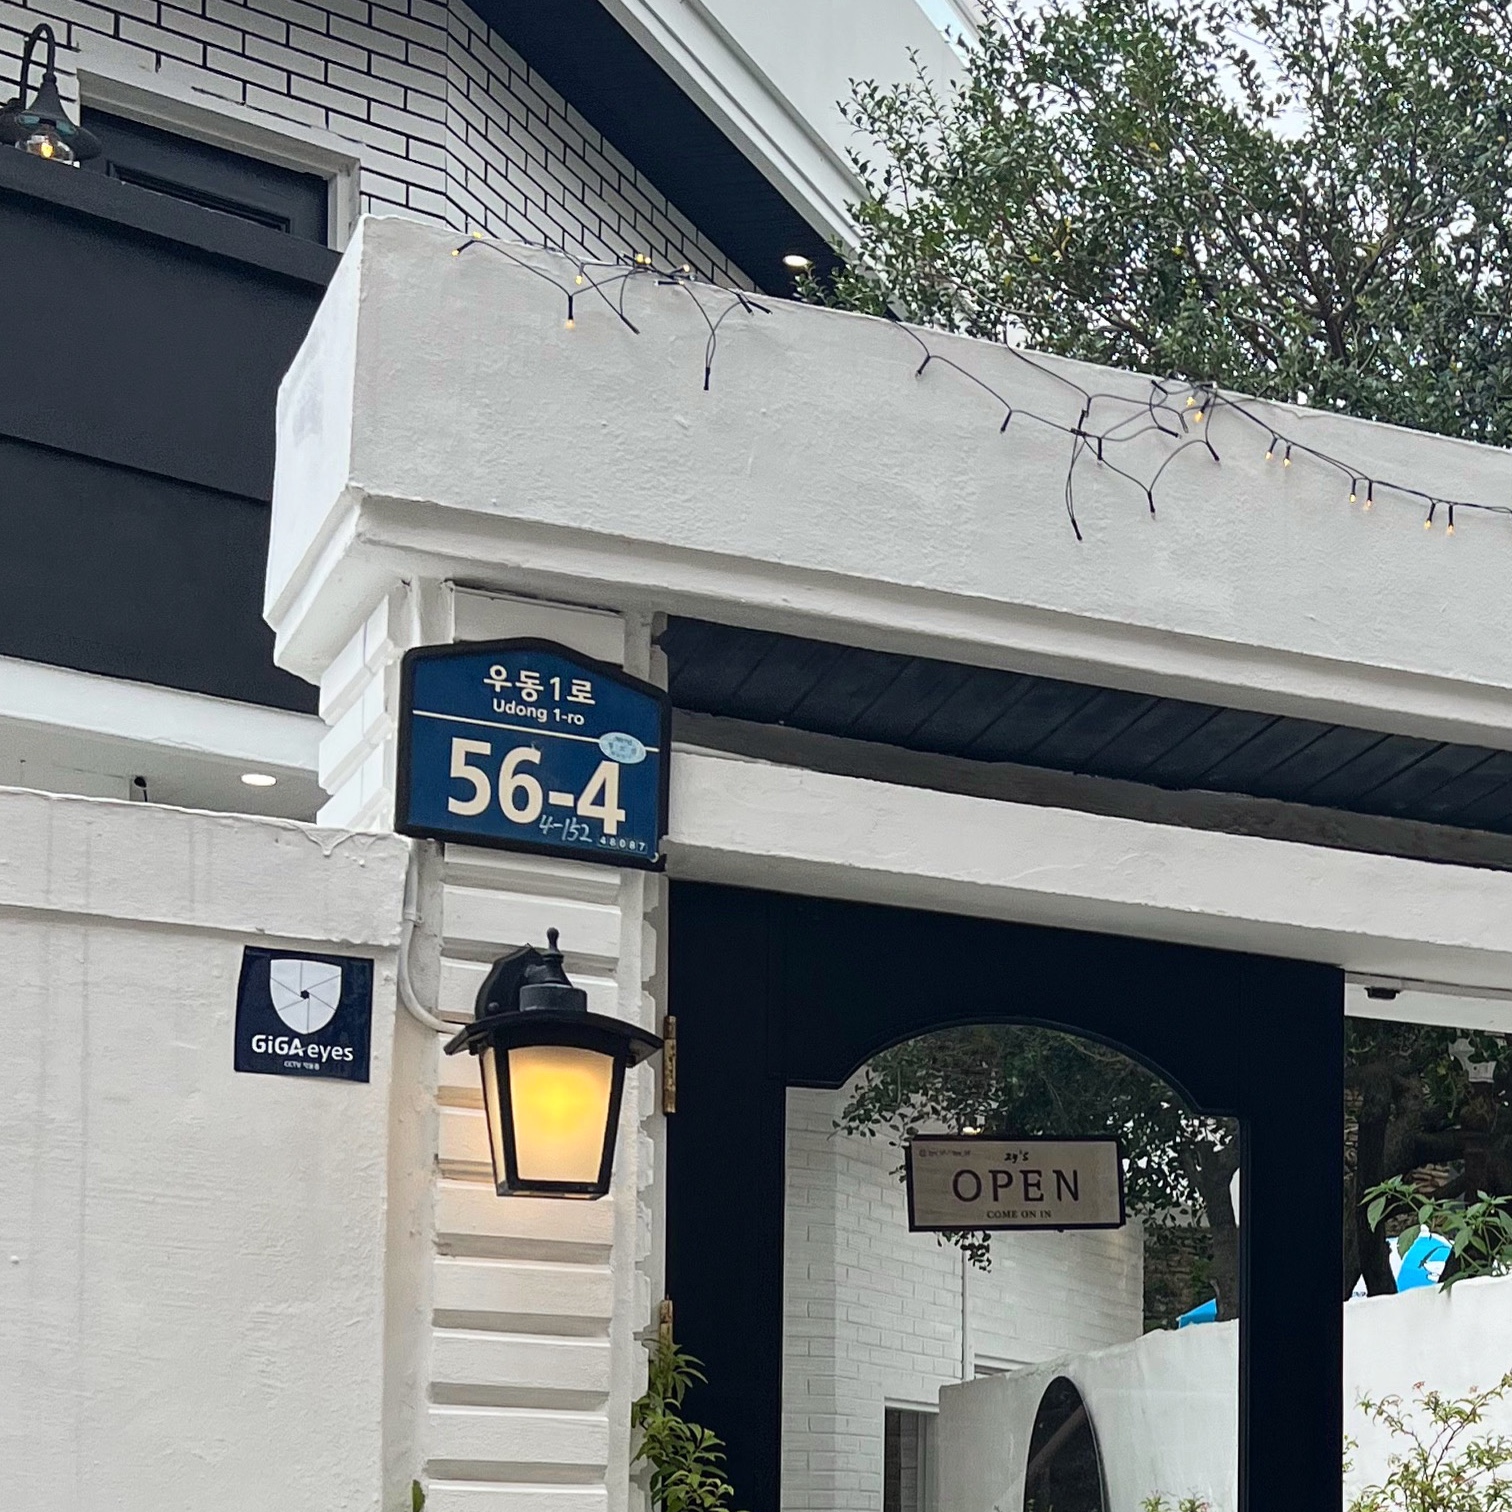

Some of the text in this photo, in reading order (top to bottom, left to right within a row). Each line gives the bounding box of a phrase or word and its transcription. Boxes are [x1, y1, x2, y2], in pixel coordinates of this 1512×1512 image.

[483, 664, 596, 706] 우동1로
[492, 699, 586, 726] Udong 1-ro
[447, 736, 626, 836] 56-4
[539, 814, 593, 843] 4-152
[600, 836, 646, 852] 48087
[952, 1168, 1080, 1203] OPEN
[986, 1210, 1052, 1219] COME ON IN
